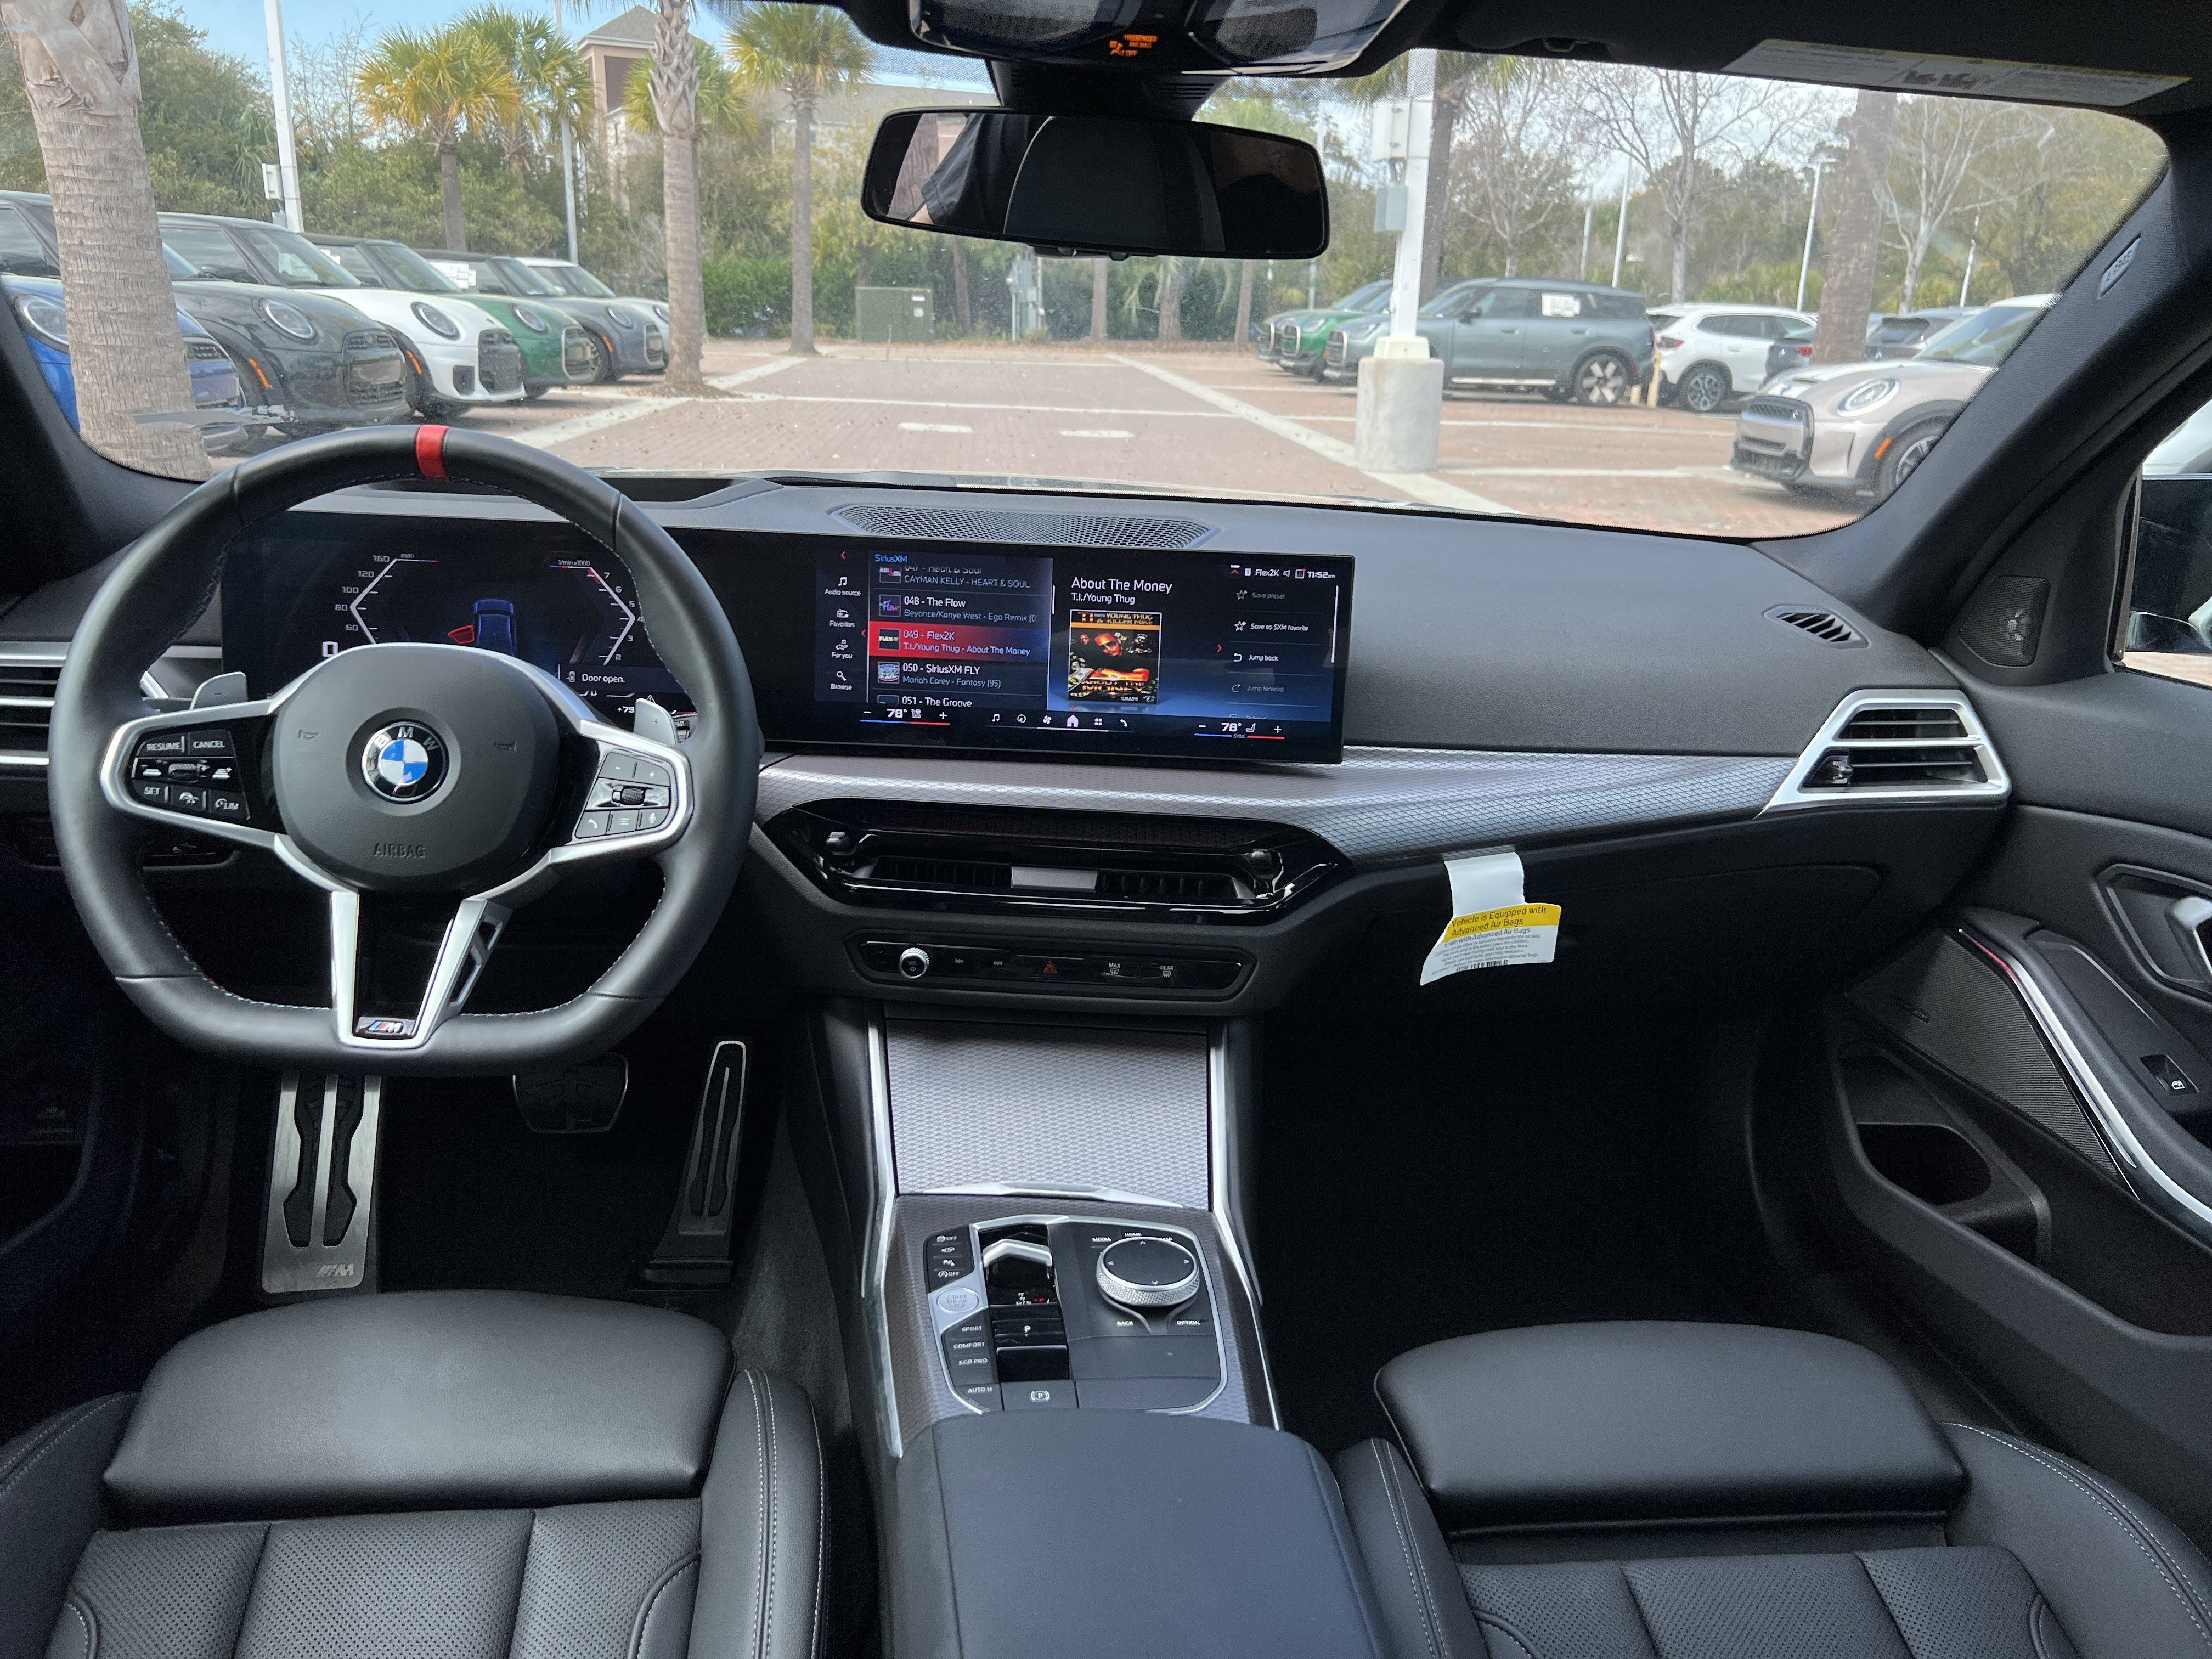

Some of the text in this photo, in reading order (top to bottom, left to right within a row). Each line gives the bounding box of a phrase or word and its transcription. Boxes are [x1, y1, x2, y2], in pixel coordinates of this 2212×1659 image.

[1124, 34, 1158, 42] PASSENGER
[875, 554, 907, 563] SiriusXM
[1255, 568, 1279, 577] Flex2K
[905, 575, 938, 584] CAYMAN
[940, 577, 964, 585] KELLY
[971, 578, 998, 587] HEART
[1071, 578, 1172, 594] About The Money
[904, 596, 919, 606] 048
[927, 597, 943, 606] The
[945, 598, 966, 607] Flow
[1114, 594, 1136, 605] Thug
[904, 610, 961, 620] Beyonce/Kanye
[963, 612, 981, 620] West
[989, 613, 1003, 622] Ego
[904, 630, 919, 639] 049
[927, 631, 955, 641] Flex2K
[322, 641, 338, 657] 0
[941, 644, 960, 654] Thug
[967, 645, 989, 654] About
[990, 646, 1005, 654] The
[1006, 647, 1030, 657] Money
[902, 663, 918, 673] 050
[926, 664, 962, 674] SiriusXM
[964, 666, 980, 675] FLY
[582, 673, 625, 685] Door open.
[902, 676, 928, 684] Mariah
[929, 677, 950, 686] Carey
[957, 678, 986, 687] Fantasy
[988, 679, 1001, 689] (95)
[902, 696, 916, 705] 051
[924, 697, 941, 706] The
[943, 698, 972, 708] Groove
[193, 740, 225, 749] CANCEL
[375, 726, 439, 751] BMW
[146, 741, 181, 751] RESUME
[144, 787, 160, 796] SET
[224, 801, 239, 810] LIM
[374, 842, 426, 859] AIRBAG
[1452, 906, 1547, 928] Vehicle is Equipped with
[1451, 917, 1523, 937] Advanced Air Bags
[1444, 939, 1458, 948] Even
[1472, 929, 1503, 940] Advanced
[953, 1341, 985, 1350] COMFORT
